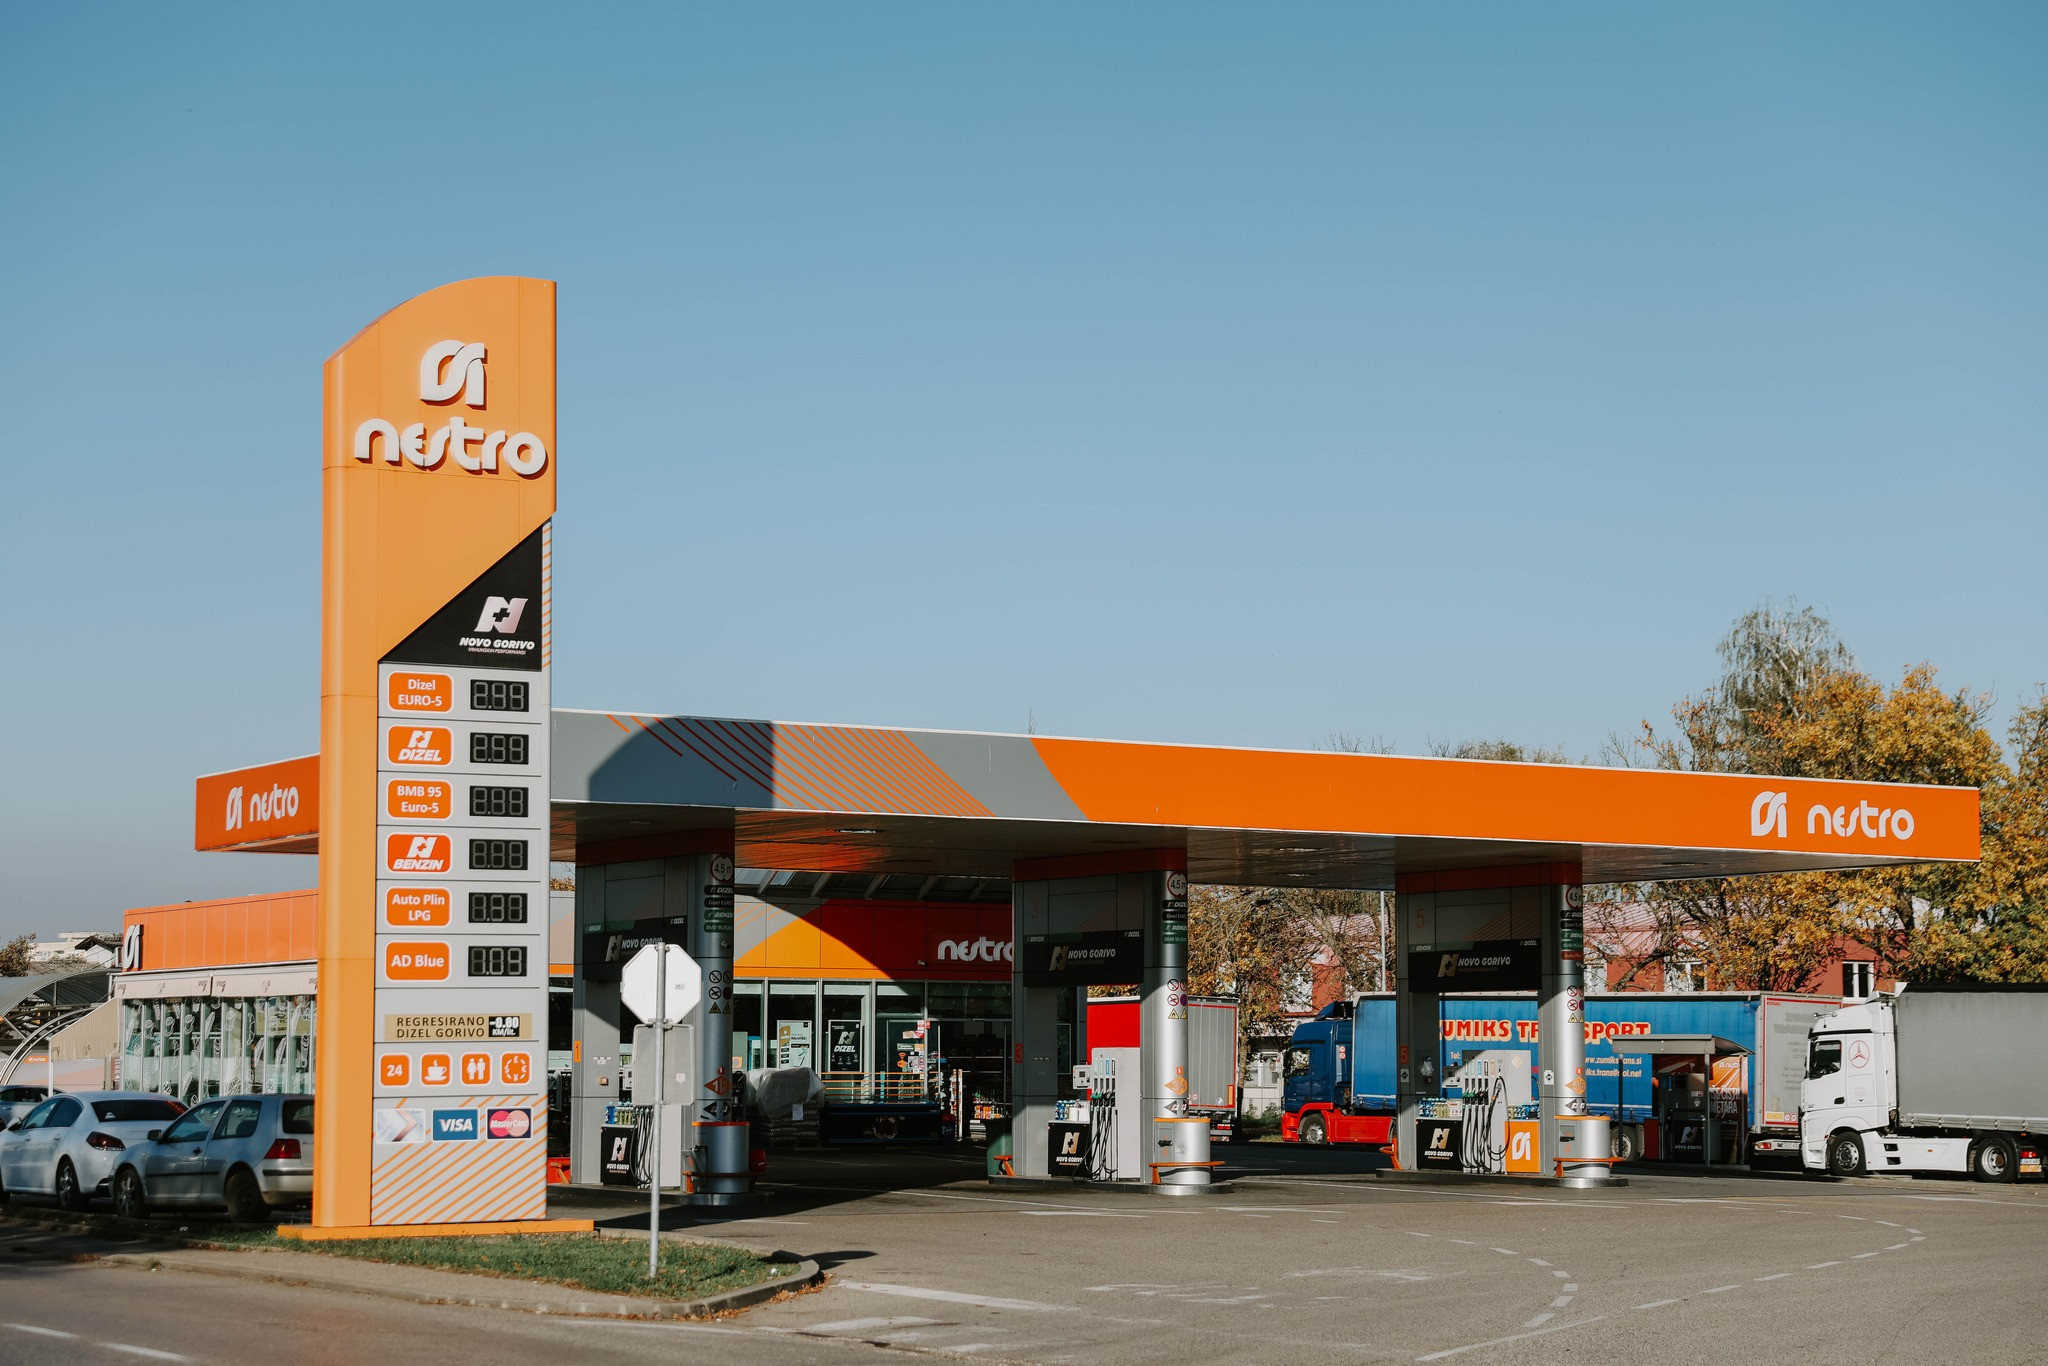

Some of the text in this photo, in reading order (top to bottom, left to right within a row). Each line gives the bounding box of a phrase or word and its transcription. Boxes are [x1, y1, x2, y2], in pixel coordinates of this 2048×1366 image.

[354, 417, 547, 476] nestro
[459, 637, 536, 650] NOVO GORIVO
[408, 679, 437, 690] Dizel
[398, 694, 443, 707] EURO-5
[397, 749, 442, 762] DIZEL
[397, 785, 442, 798] BMB 95
[249, 783, 299, 822] nestro
[401, 801, 440, 814] Euro-5
[1807, 800, 1915, 840] nestro
[393, 858, 445, 871] BENZIN
[392, 894, 446, 906] Auto Plin
[408, 910, 431, 922] LPG
[621, 938, 640, 949] NOVO
[1068, 948, 1116, 959] NOVO GORIVO
[391, 954, 445, 968] AD Blue
[1458, 956, 1511, 967] NOVO GORIVO
[397, 1016, 485, 1027] REGRESIRANO
[397, 1028, 432, 1038] DIZEL
[435, 1027, 485, 1038] GORIVO
[1440, 1019, 1513, 1041] UMIKS
[834, 1045, 856, 1053] DIZEL
[386, 1064, 404, 1078] 24
[438, 1118, 529, 1132] VISA MasterCard
